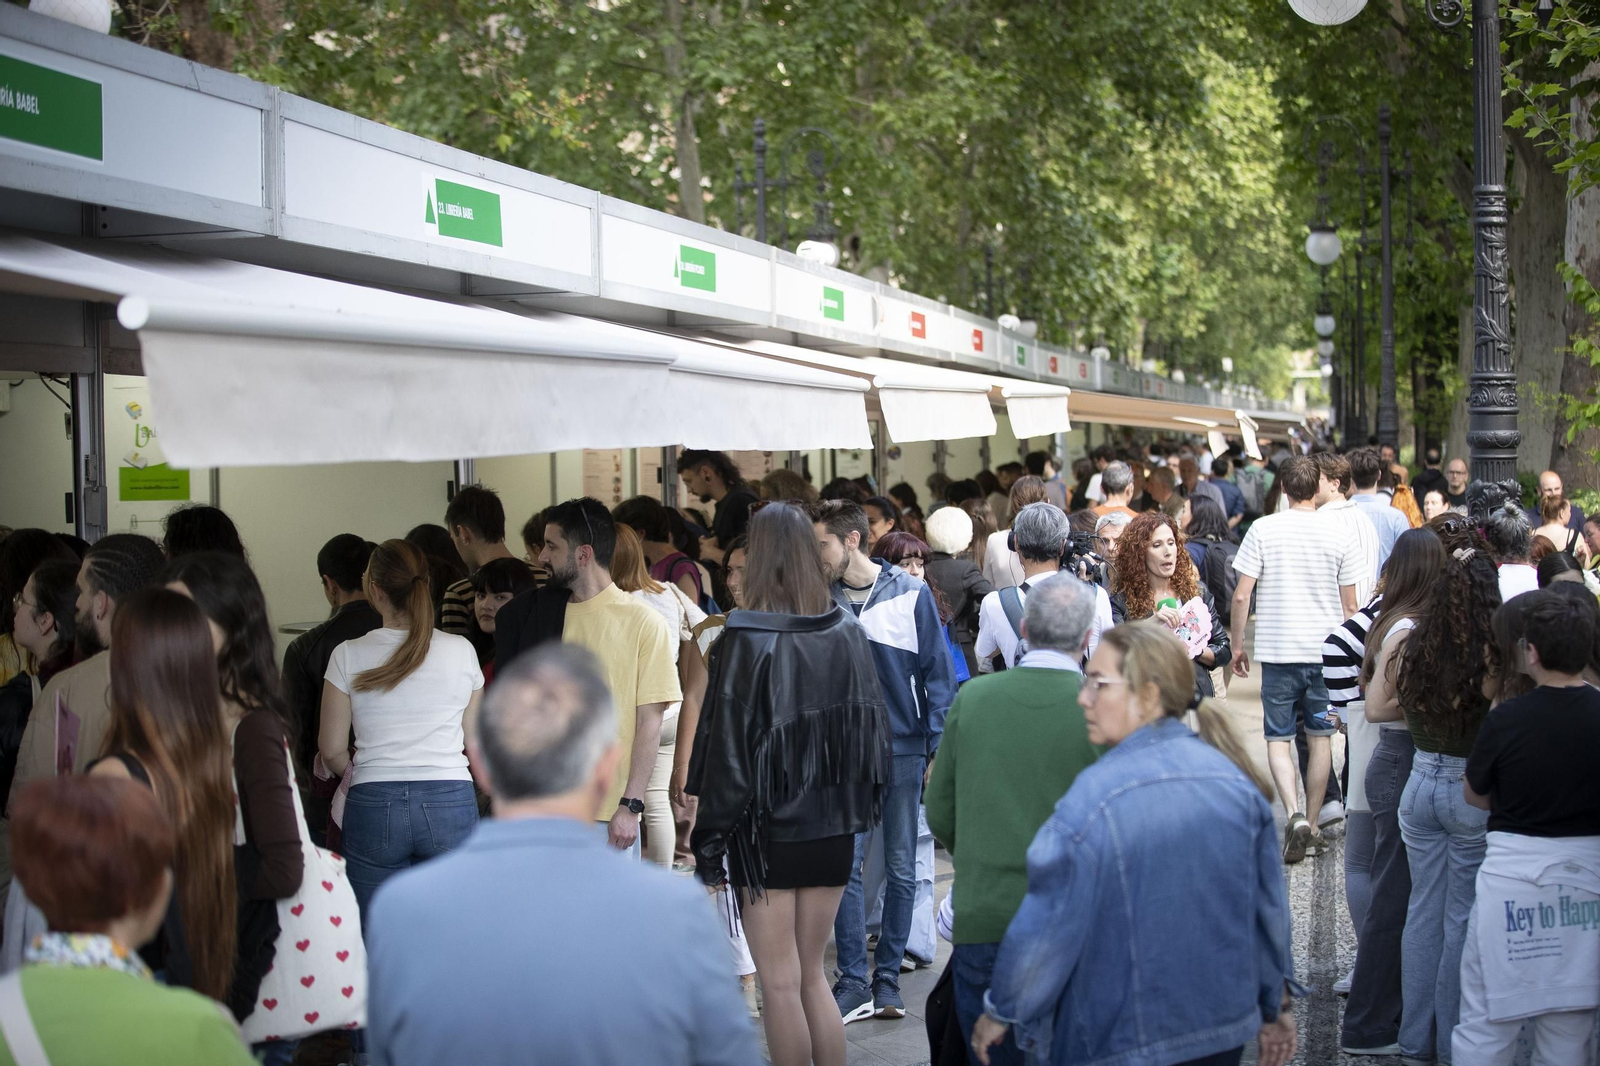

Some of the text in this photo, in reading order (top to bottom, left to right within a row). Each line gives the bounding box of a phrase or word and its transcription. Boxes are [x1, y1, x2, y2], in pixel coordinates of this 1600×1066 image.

[0, 82, 40, 115] RÍA BABEL
[1504, 900, 1535, 937] Key
[1538, 901, 1555, 929] to
